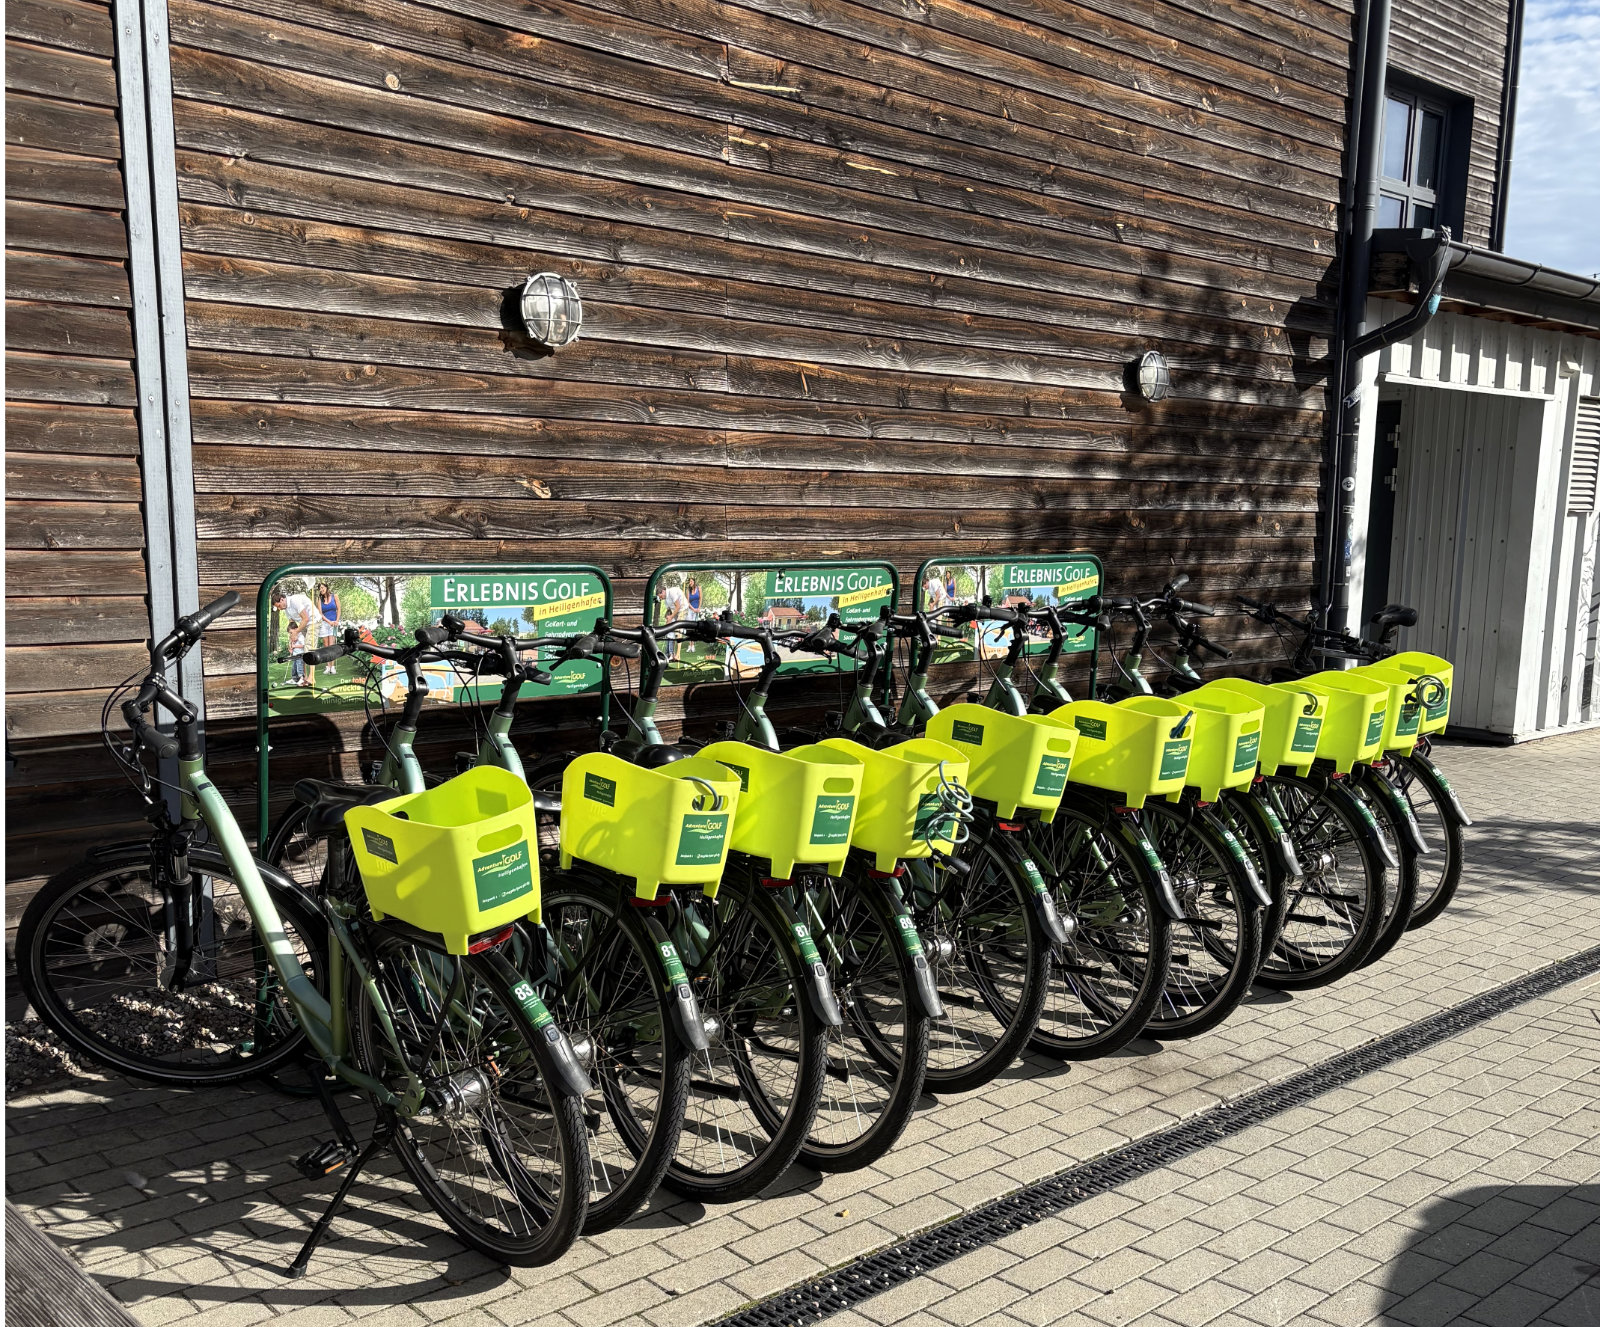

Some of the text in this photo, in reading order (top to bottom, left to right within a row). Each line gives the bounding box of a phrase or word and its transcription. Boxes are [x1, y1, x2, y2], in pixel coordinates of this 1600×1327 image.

[774, 572, 883, 593] ERLEBNIS GOLF
[1009, 565, 1091, 584] ERLEBNIS GOLF
[443, 578, 590, 602] ERLEBNIS GOLF
[849, 588, 888, 602] Heiligenhafe
[539, 596, 603, 616] in Heiligenhafen
[708, 821, 723, 830] GOLF
[477, 850, 522, 873] Adventure GOLF
[795, 924, 809, 938] 87
[899, 916, 914, 929] 89
[661, 944, 677, 958] 81
[514, 983, 534, 1001] 83
